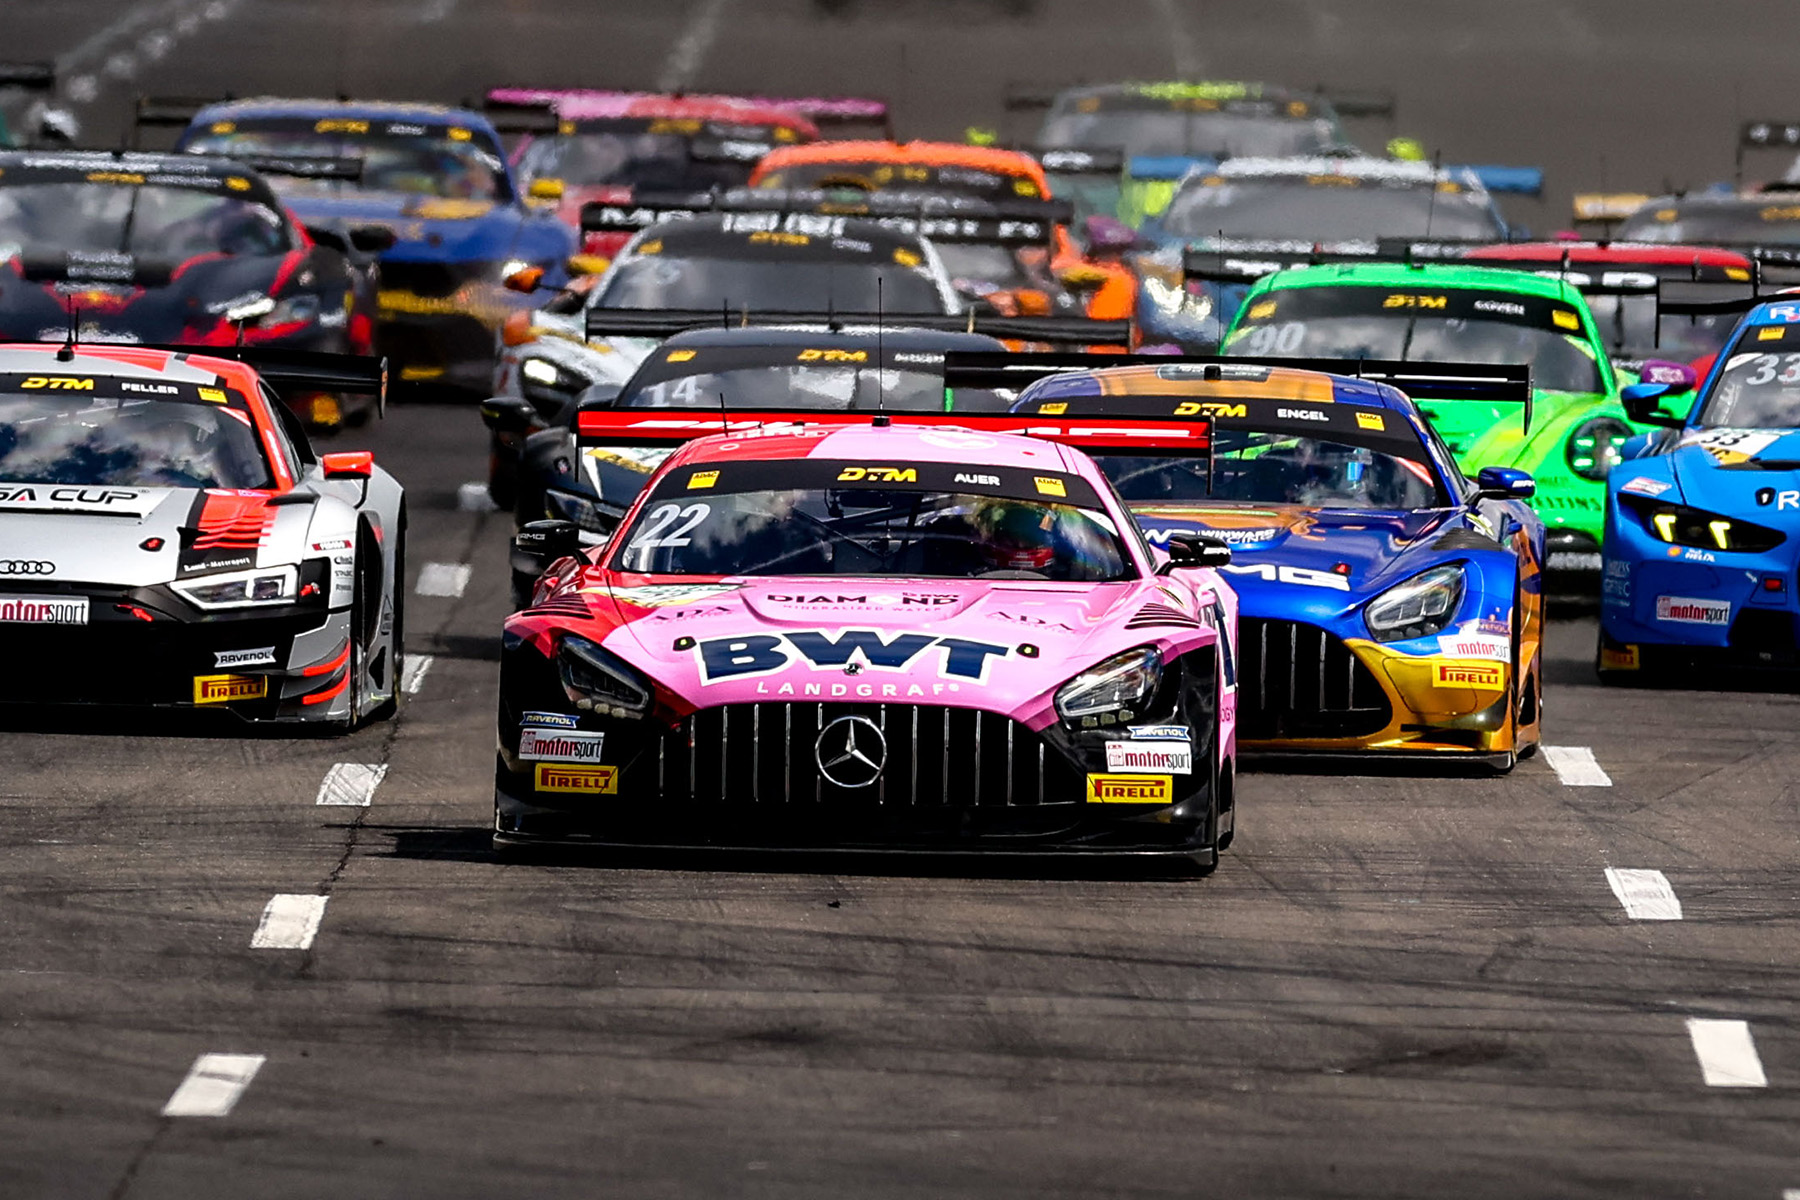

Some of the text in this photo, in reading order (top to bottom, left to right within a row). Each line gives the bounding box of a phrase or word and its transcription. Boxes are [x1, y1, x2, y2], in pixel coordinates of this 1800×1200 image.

[1249, 322, 1307, 354] 90
[797, 349, 868, 361] DTM
[20, 377, 178, 394] DTM FELLER
[645, 375, 703, 407] 14
[1174, 402, 1329, 421] DTM ENGEL
[837, 467, 1000, 486] DTM AUER
[50, 488, 138, 504] CUP
[632, 503, 711, 548] 22
[0, 599, 86, 625] otorsport
[1670, 604, 1729, 623] motorsport
[220, 651, 271, 664] RAVENOL
[698, 629, 1011, 681] BWT
[1439, 666, 1499, 684] PIRELLI
[201, 680, 262, 698] PIRELLI
[533, 738, 601, 759] motorsport
[1125, 751, 1190, 770] motorsport
[540, 768, 611, 789] PIRELLI
[1094, 779, 1166, 797] PIRELLI
